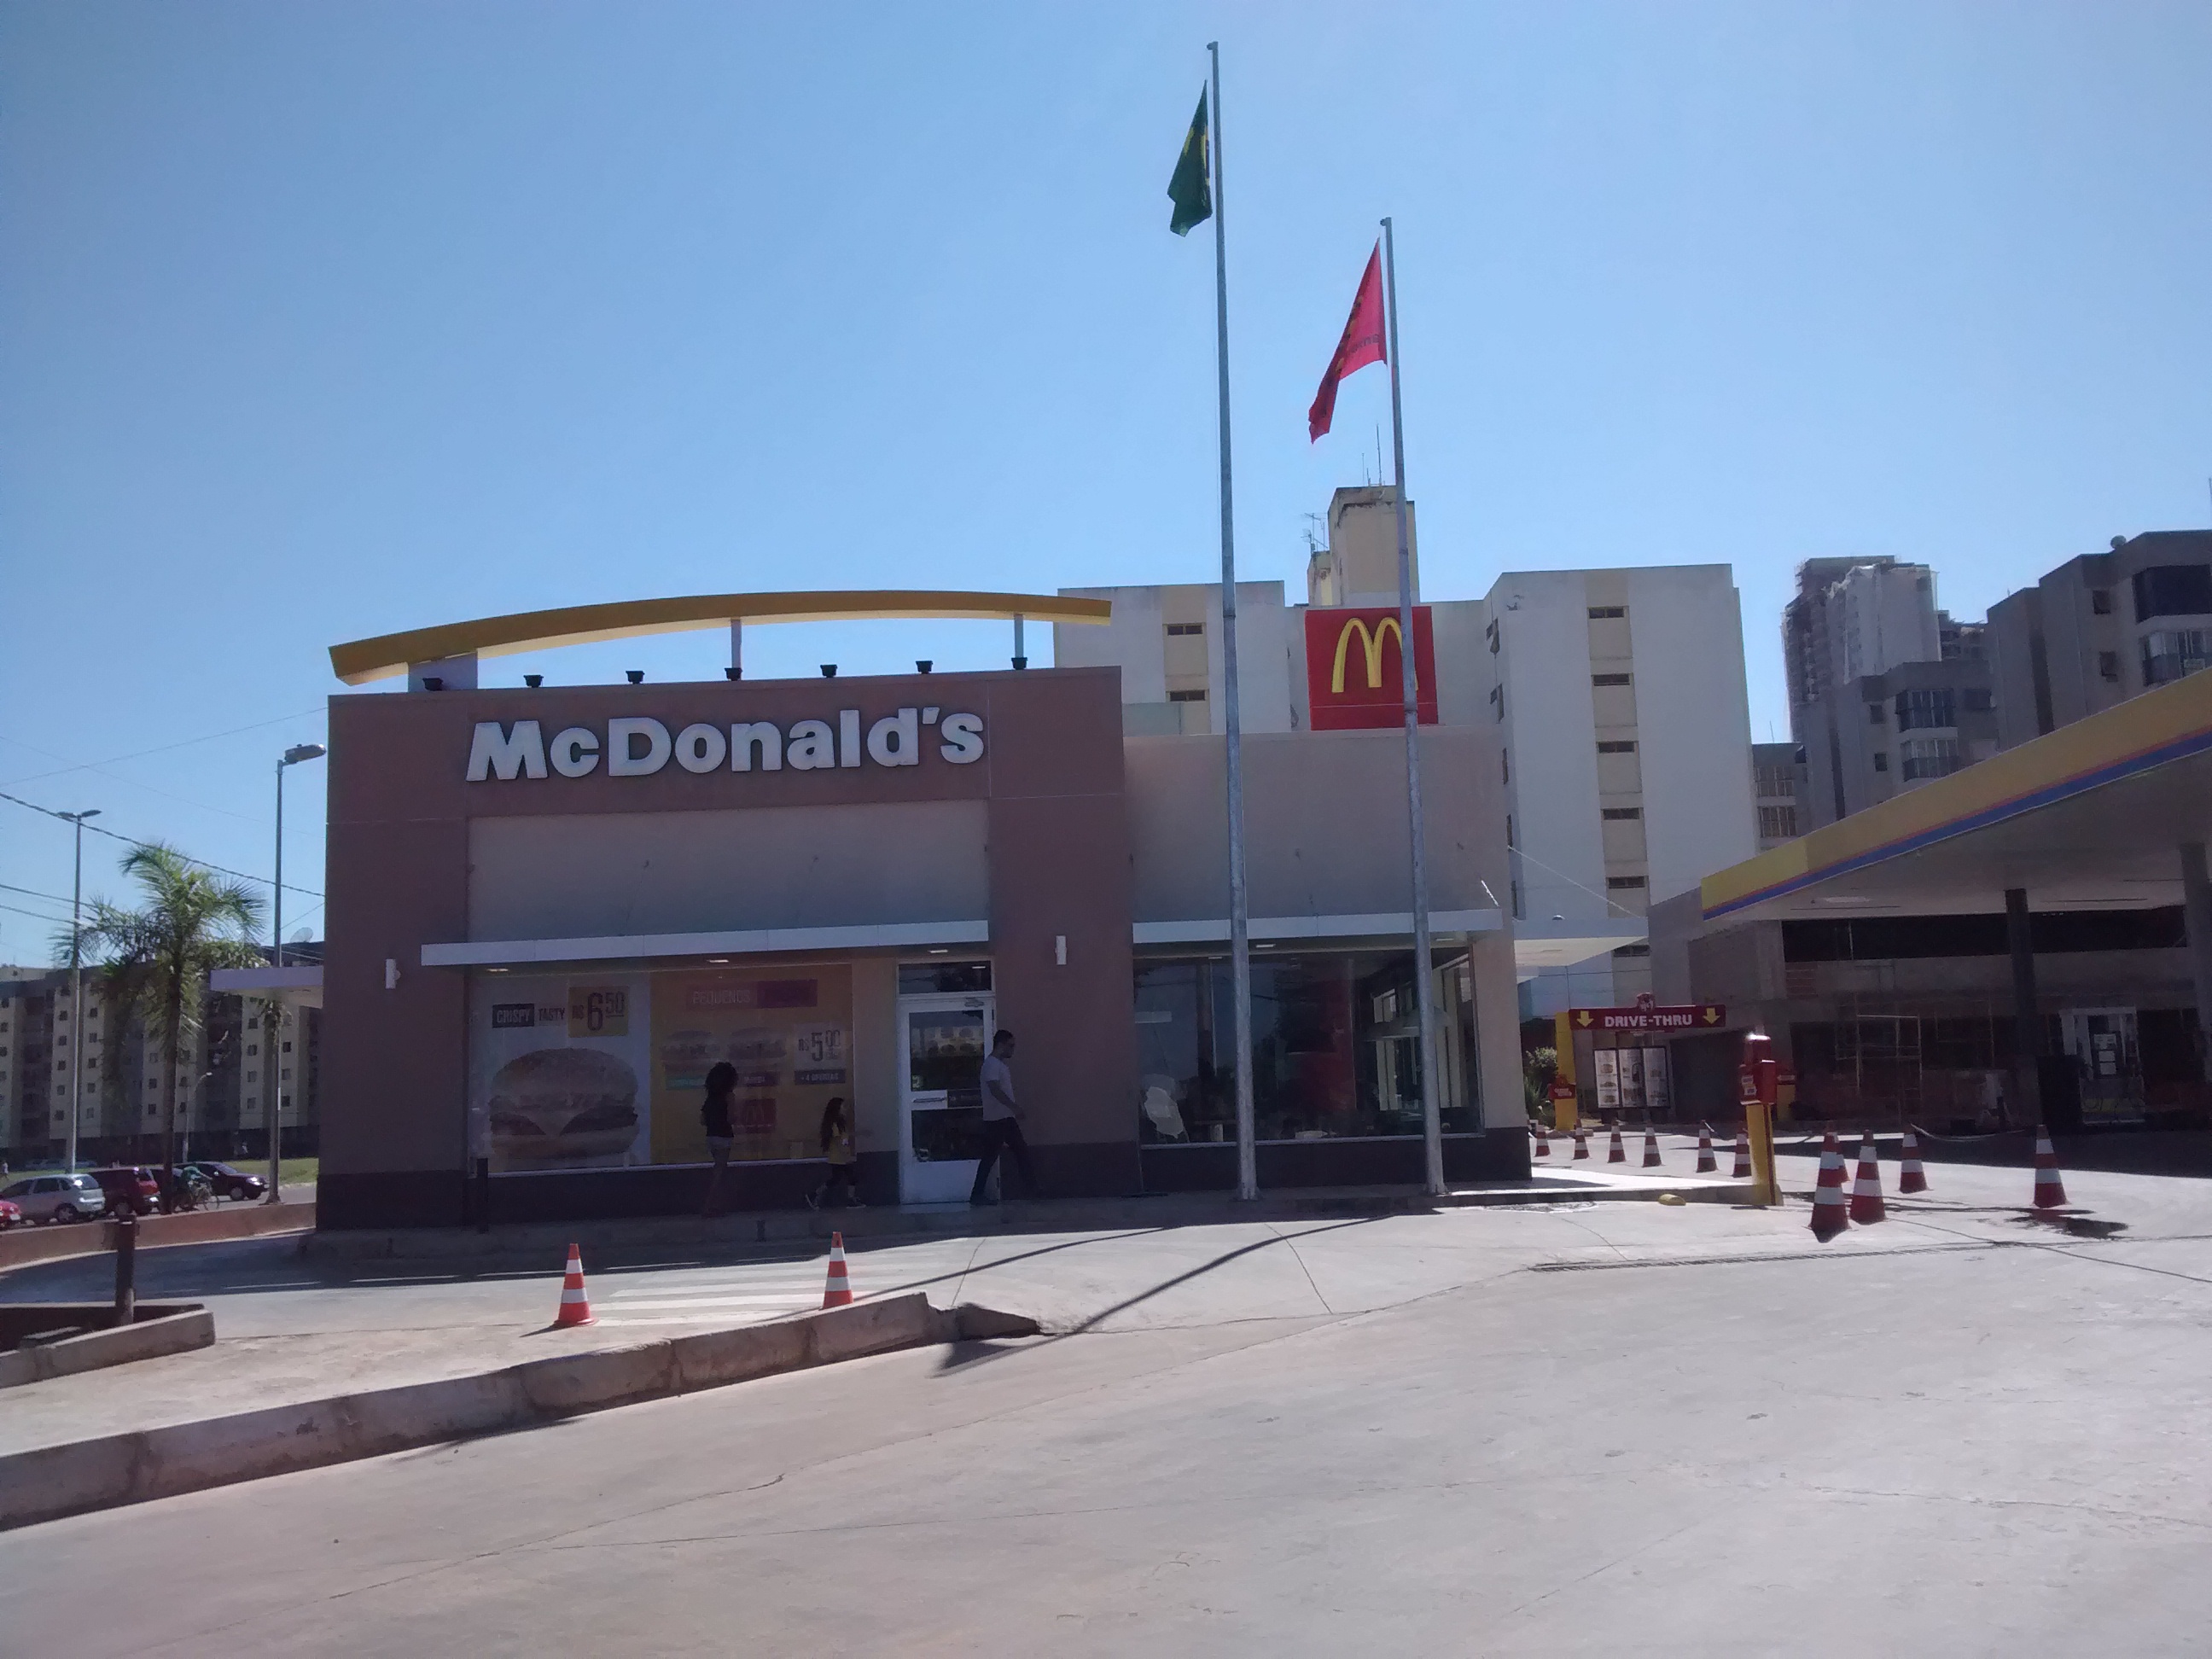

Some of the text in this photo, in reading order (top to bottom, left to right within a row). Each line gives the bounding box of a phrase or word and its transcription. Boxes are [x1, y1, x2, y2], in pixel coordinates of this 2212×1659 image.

[466, 707, 985, 782] McDonald's
[496, 1007, 566, 1024] CRISPY TASTY
[1604, 1014, 1692, 1027] DRIVE-THRU
